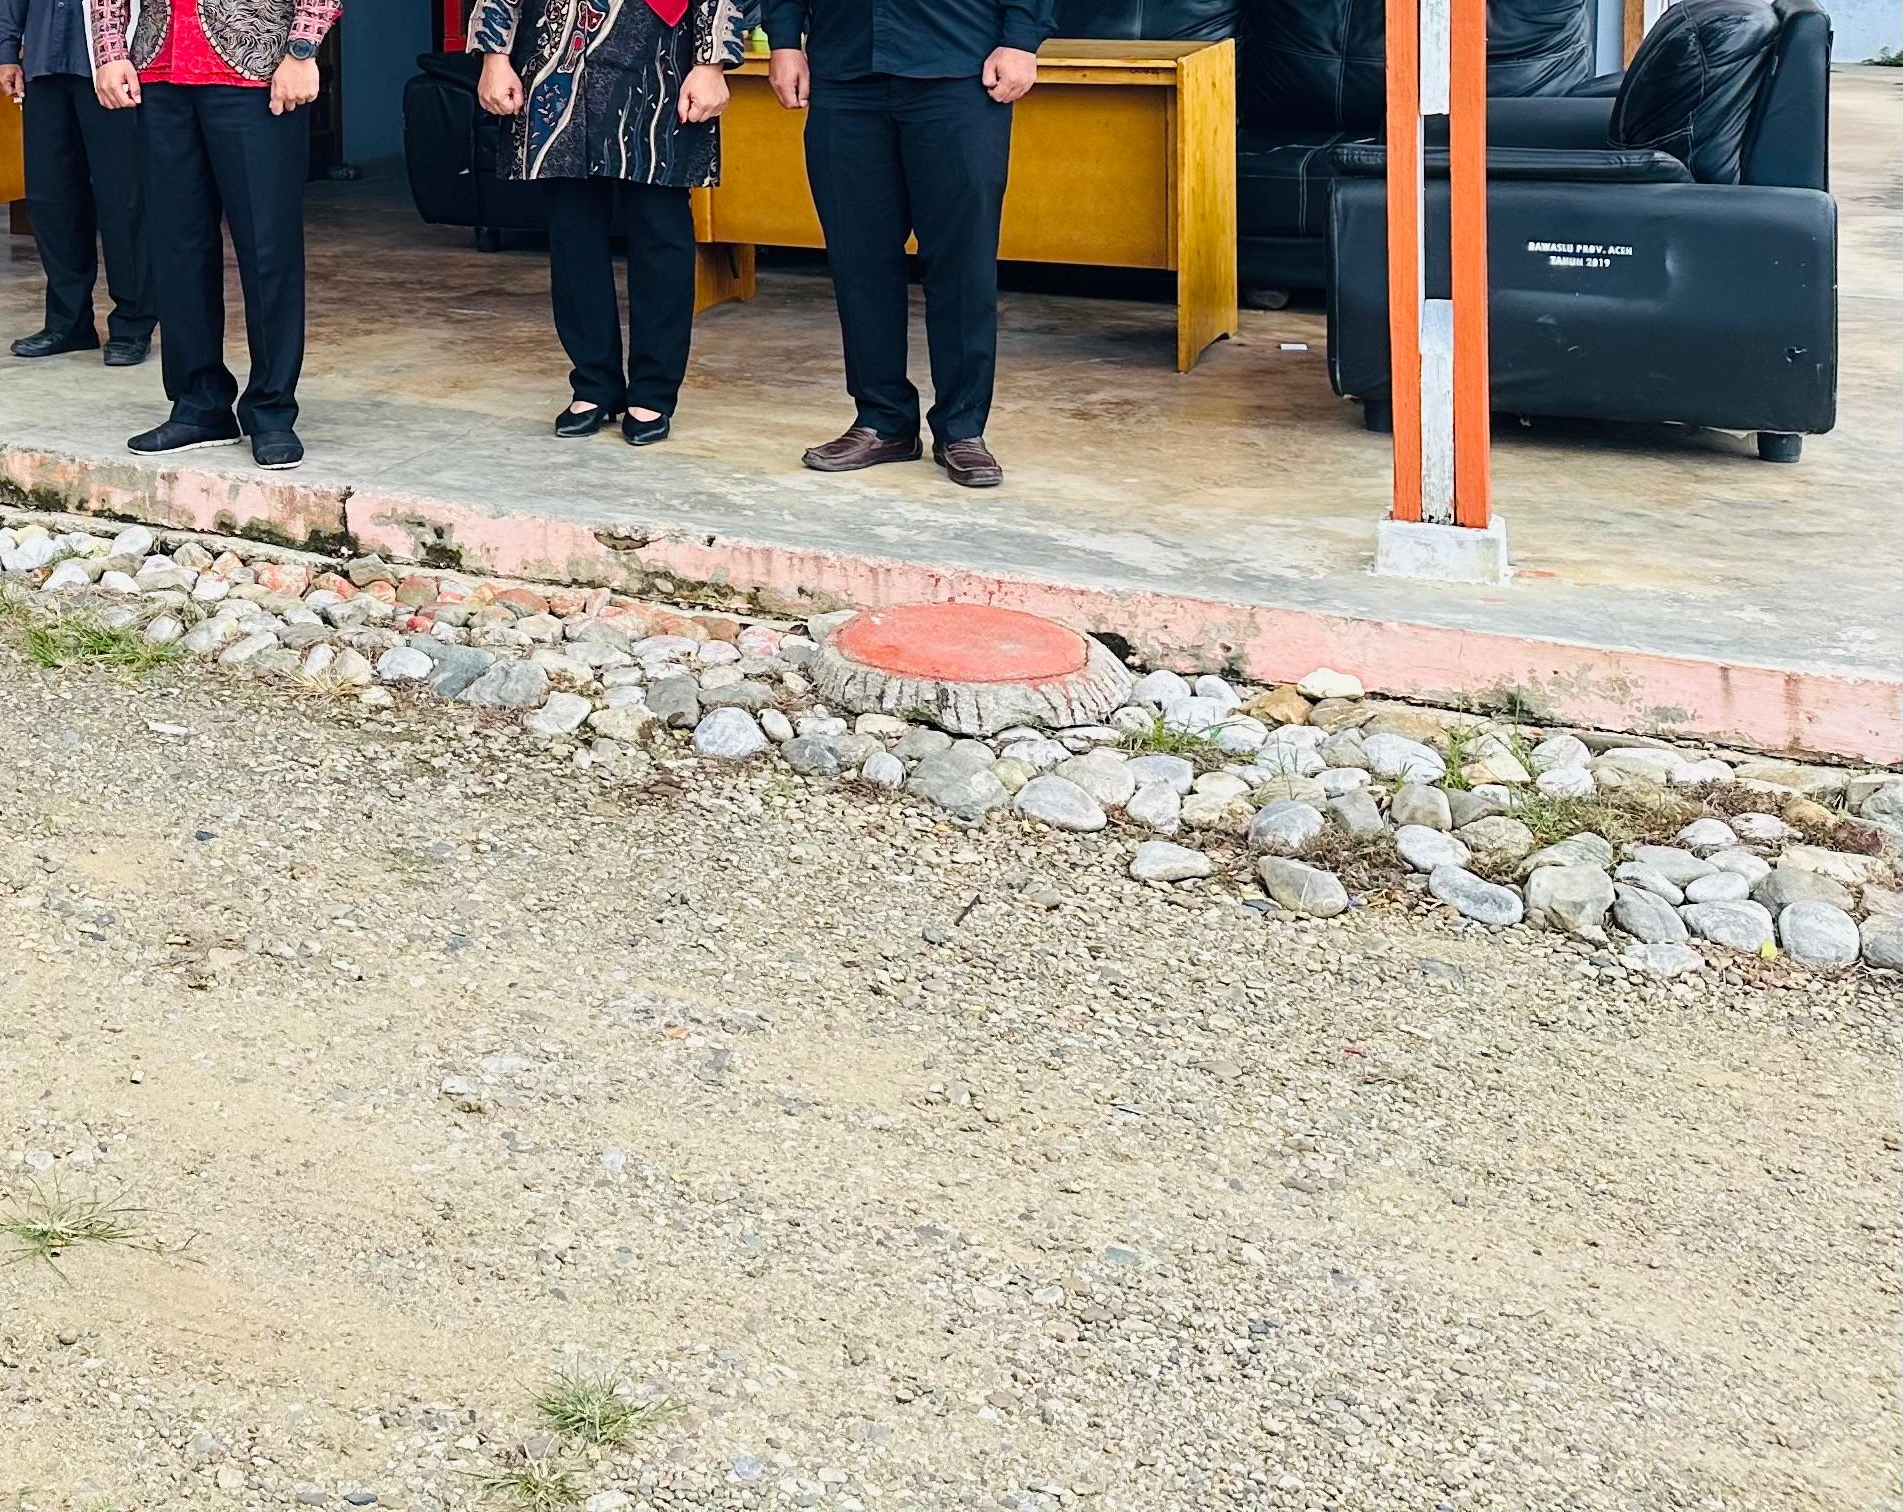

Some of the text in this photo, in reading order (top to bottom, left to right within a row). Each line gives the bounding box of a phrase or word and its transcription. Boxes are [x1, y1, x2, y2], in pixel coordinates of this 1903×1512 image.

[1527, 241, 1633, 256] BAWASLU PROV. ACEH
[1549, 256, 1610, 267] TAHUN 2019
